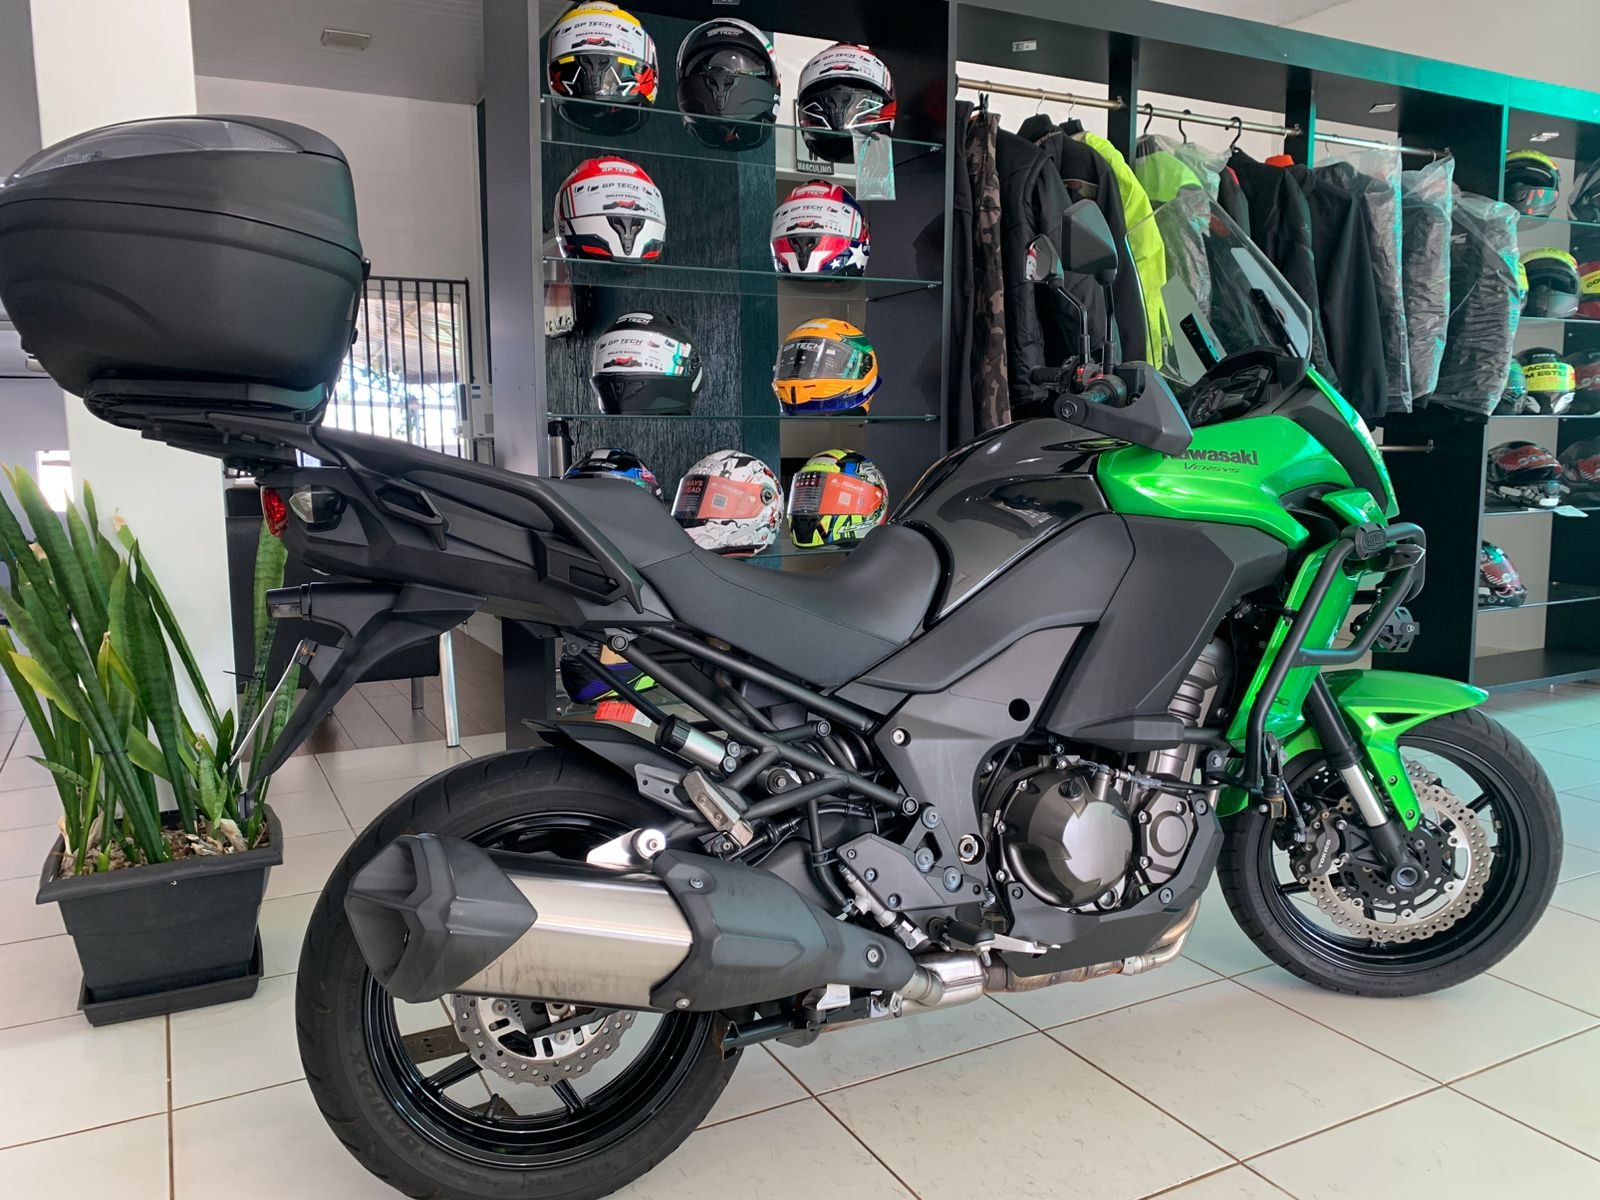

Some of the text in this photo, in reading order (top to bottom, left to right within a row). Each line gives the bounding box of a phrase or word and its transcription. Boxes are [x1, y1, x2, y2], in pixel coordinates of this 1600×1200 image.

[589, 21, 612, 29] TECH
[615, 167, 636, 175] TECH
[617, 182, 639, 191] TECH
[620, 338, 643, 346] TECH
[795, 342, 821, 351] TECH
[1317, 839, 1331, 869] TOKICO
